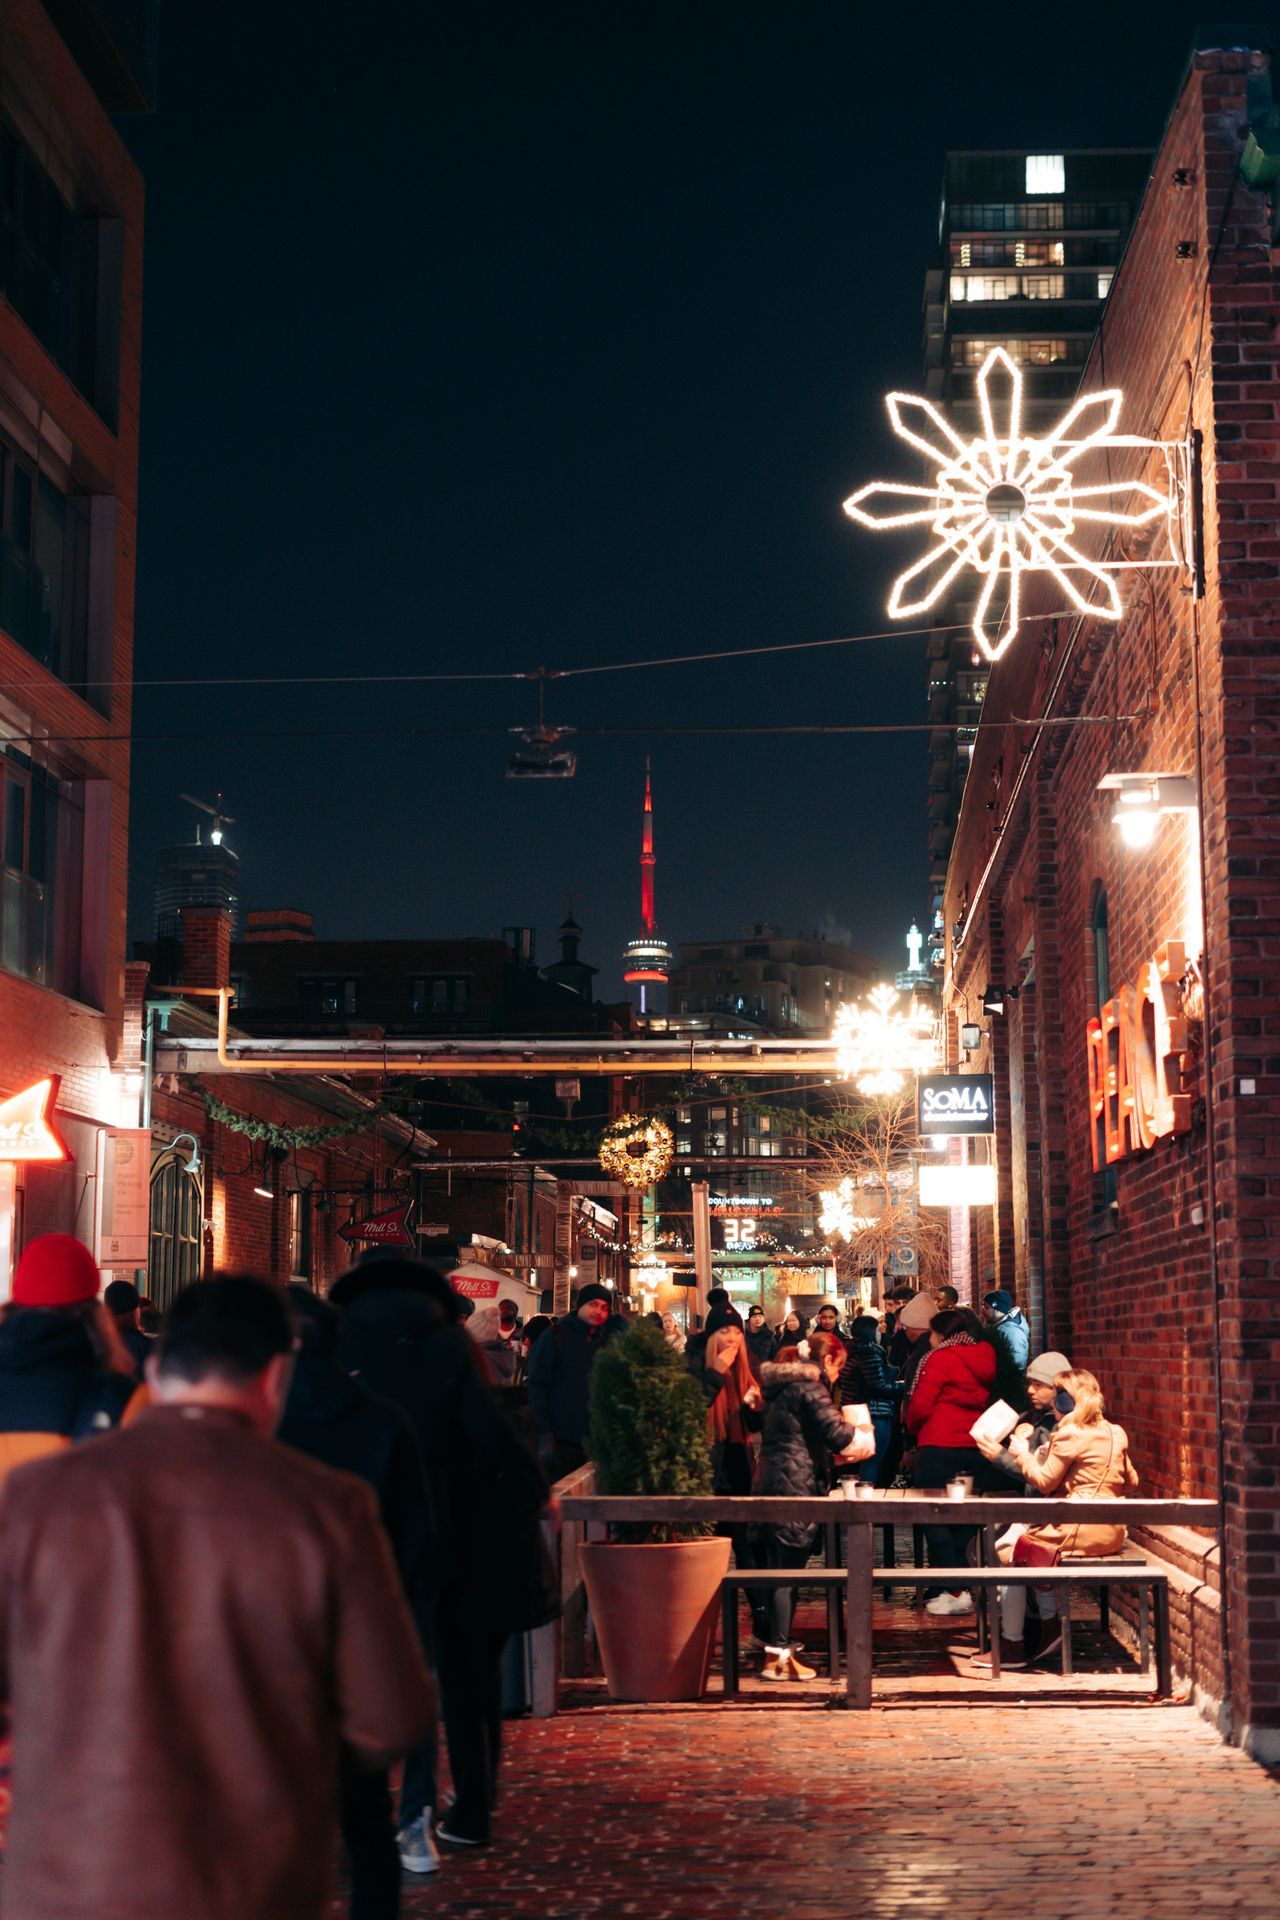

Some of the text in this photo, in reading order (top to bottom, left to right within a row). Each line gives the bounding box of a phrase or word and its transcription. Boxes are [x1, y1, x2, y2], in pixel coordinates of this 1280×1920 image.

[1087, 940, 1191, 1173] PEACE
[362, 1222, 401, 1233] Mill St.
[724, 1218, 755, 1243] 32
[455, 1280, 480, 1291] Mill
